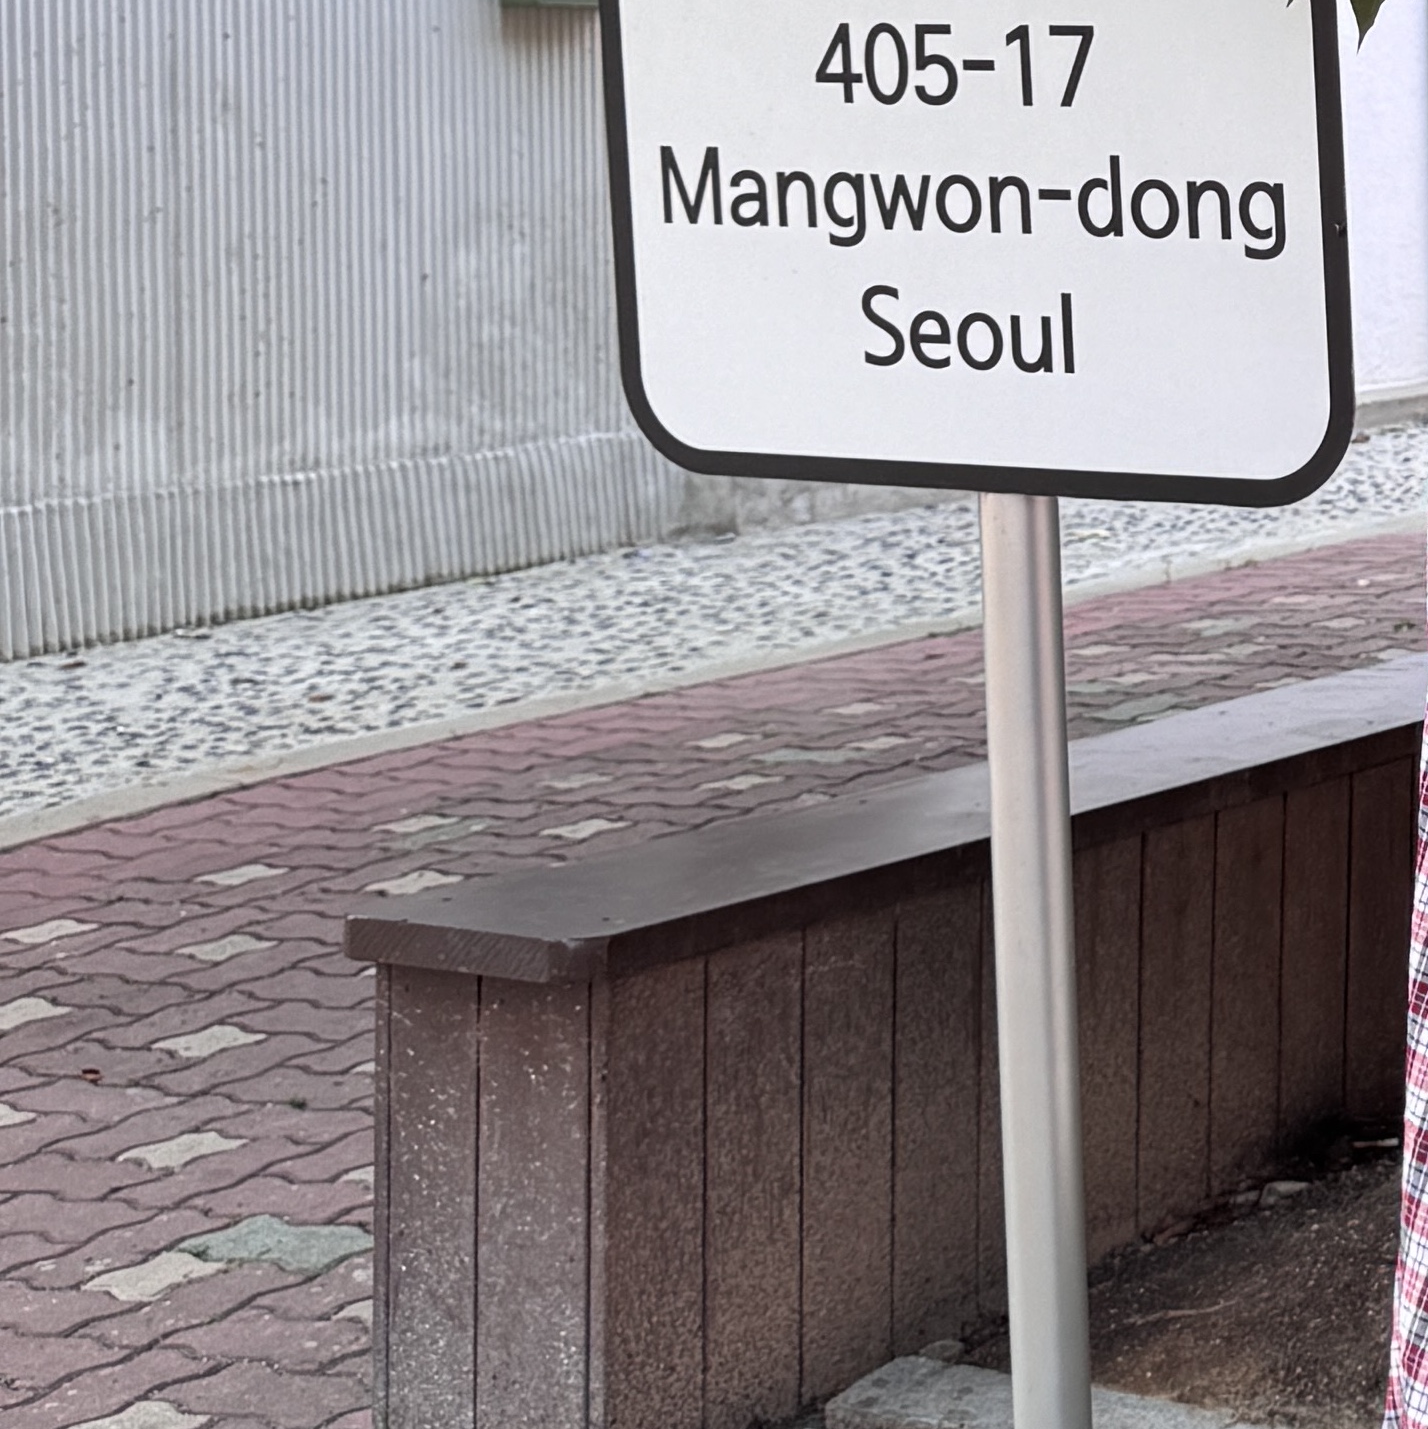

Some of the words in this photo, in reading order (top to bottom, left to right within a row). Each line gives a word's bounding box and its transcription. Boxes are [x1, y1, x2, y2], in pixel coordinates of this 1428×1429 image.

[816, 23, 1094, 107] 405-17
[661, 146, 1285, 260] Mangwon-dong
[862, 285, 1074, 373] Seoul
